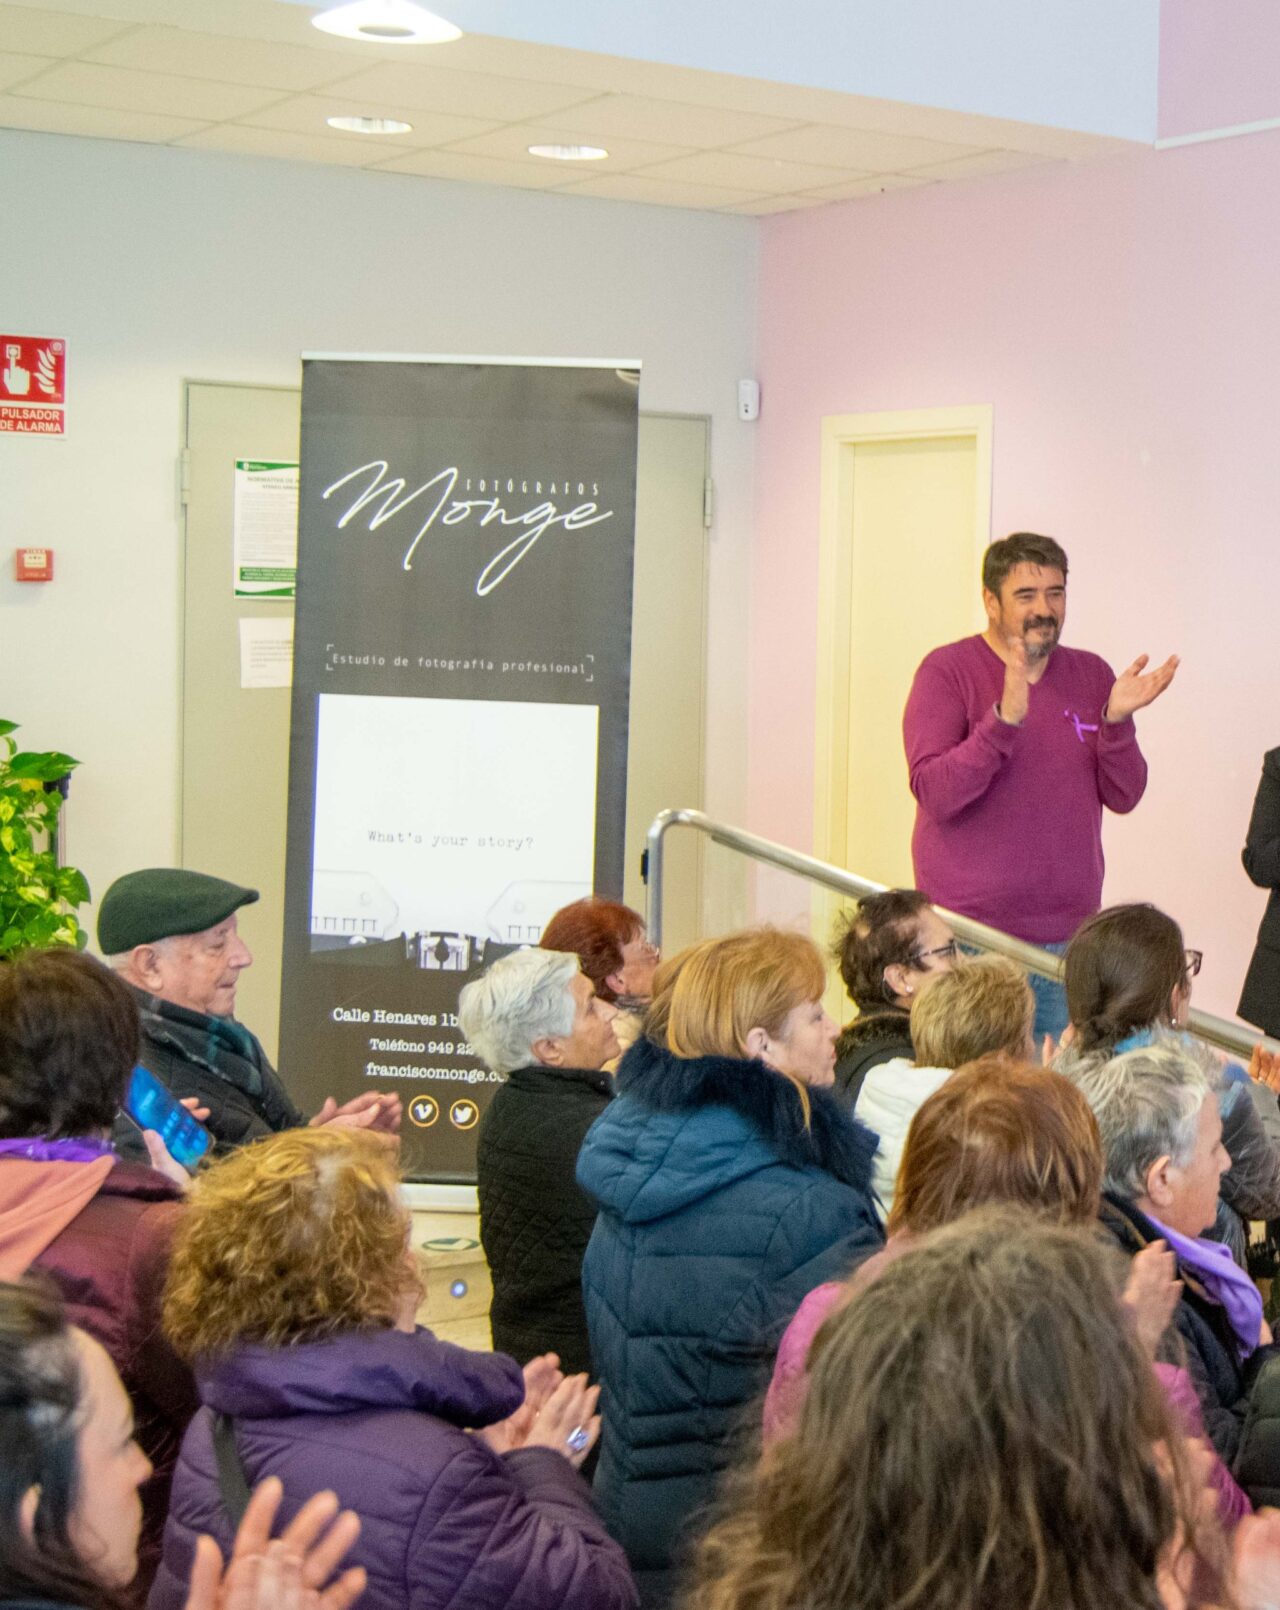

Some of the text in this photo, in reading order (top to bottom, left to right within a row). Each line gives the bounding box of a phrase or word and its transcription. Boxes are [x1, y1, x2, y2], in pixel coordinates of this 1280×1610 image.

[1, 407, 60, 420] PULSADOR
[0, 420, 62, 432] DE ALARMA
[466, 478, 599, 496] FOTÓGRAFOS
[322, 460, 613, 596] Monge
[333, 653, 386, 666] Estudio
[393, 655, 409, 667] de
[502, 660, 585, 674] profesional
[367, 830, 534, 851] What's your story?
[332, 1007, 371, 1023] Calle
[373, 1009, 437, 1026] Henares
[369, 1038, 426, 1053] Teléfono
[428, 1041, 454, 1055] 949
